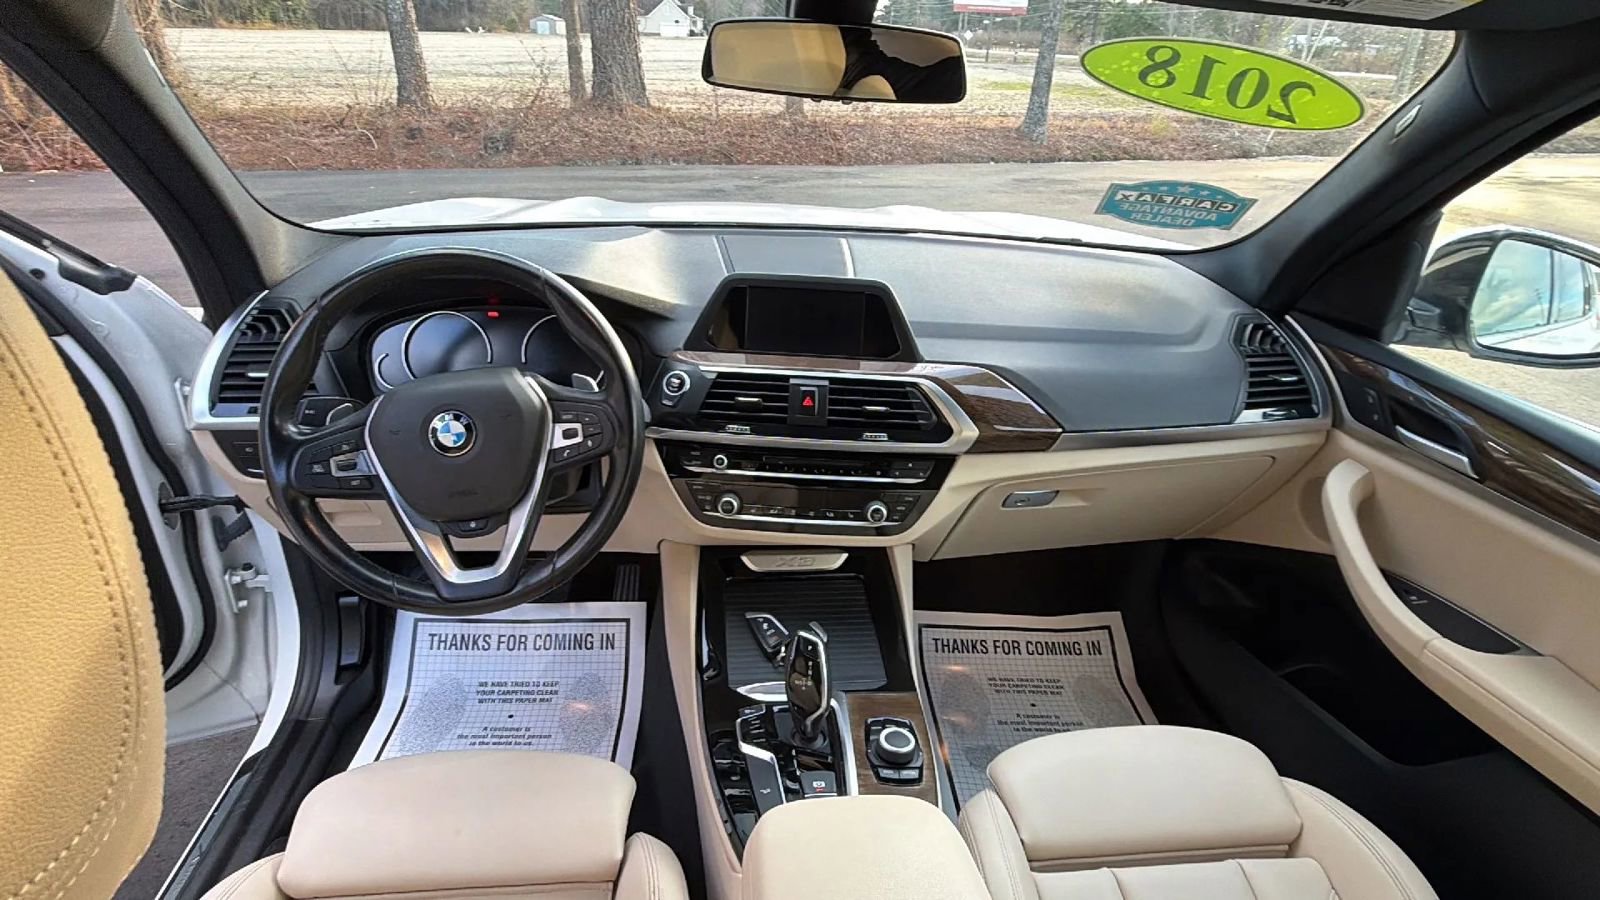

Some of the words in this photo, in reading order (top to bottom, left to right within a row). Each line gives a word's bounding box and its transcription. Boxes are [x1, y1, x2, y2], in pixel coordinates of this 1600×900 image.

[428, 633, 491, 651] THANKS
[497, 634, 527, 651] FOR
[533, 633, 594, 651] COMING
[600, 633, 616, 650] IN
[932, 638, 988, 654] THANKS
[994, 640, 1021, 656] FOR
[1026, 640, 1082, 656] COMING
[1087, 640, 1103, 656] IN
